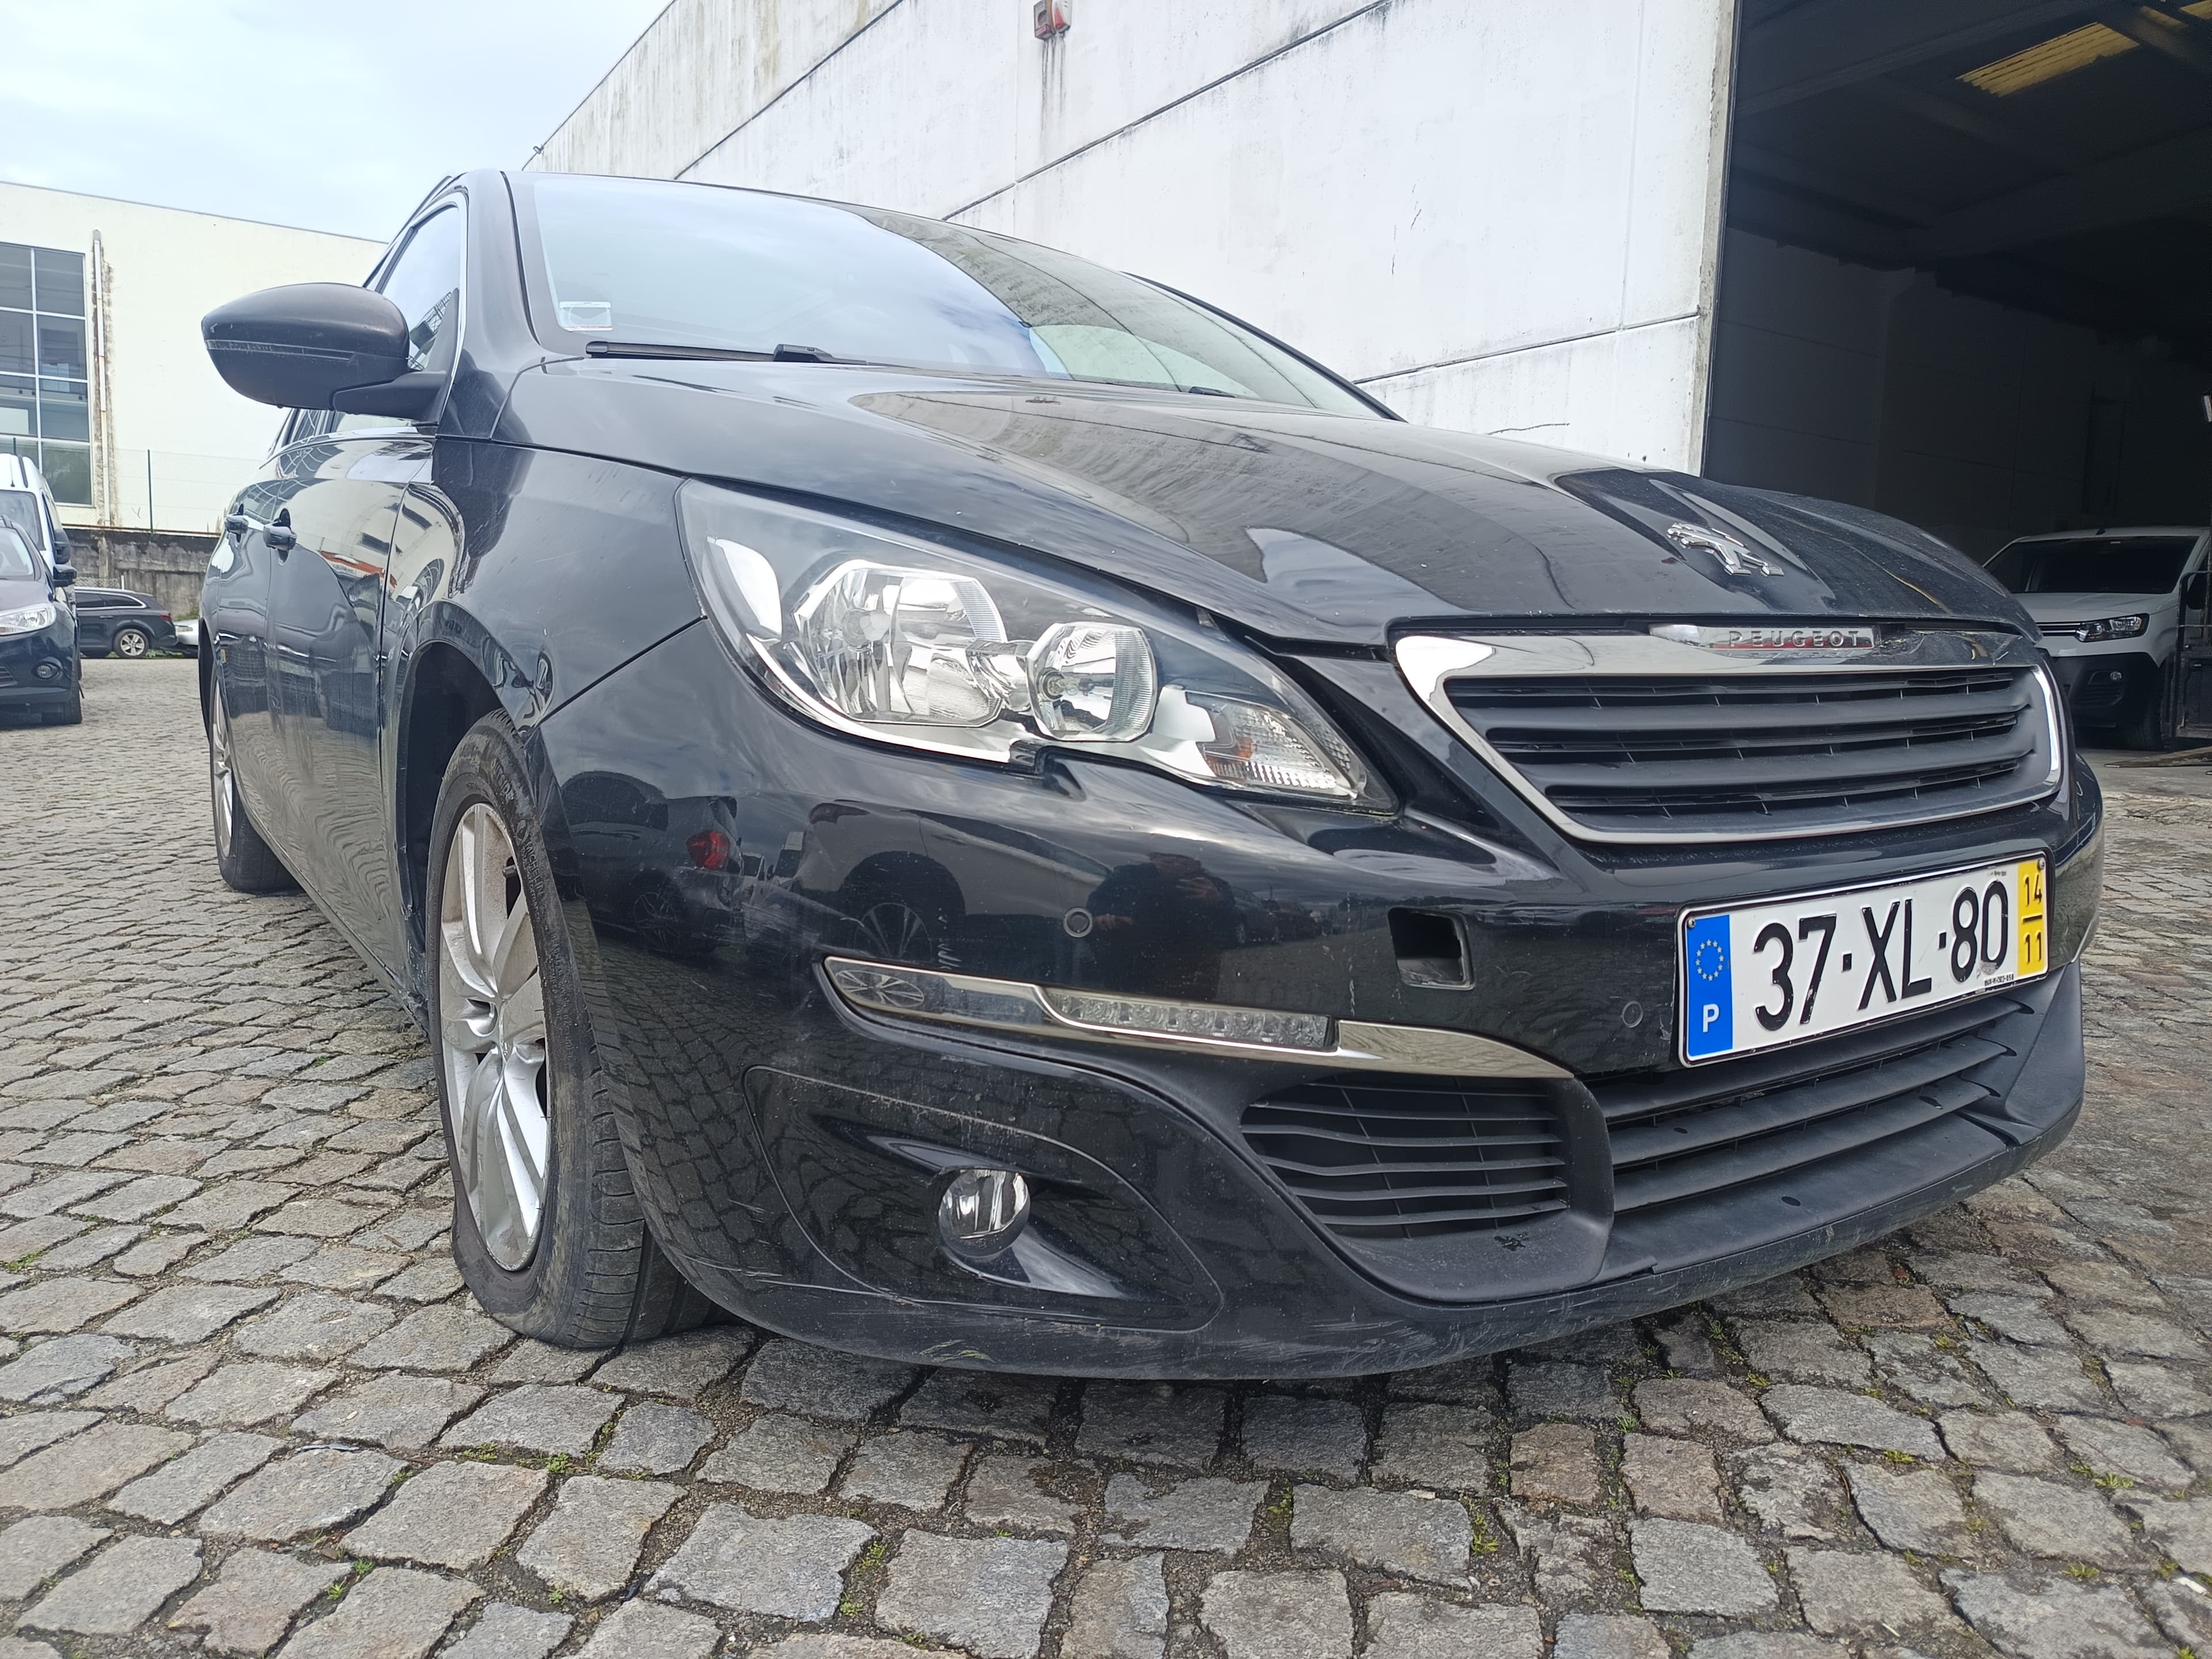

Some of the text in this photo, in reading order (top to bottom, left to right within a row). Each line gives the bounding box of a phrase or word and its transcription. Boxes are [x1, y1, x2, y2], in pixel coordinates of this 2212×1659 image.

[1729, 630, 1859, 647] PEUGEOT
[525, 842, 544, 897] MICHELIN
[2024, 874, 2043, 906] 14
[2025, 932, 2041, 964] 11
[1702, 1003, 1719, 1033] P
